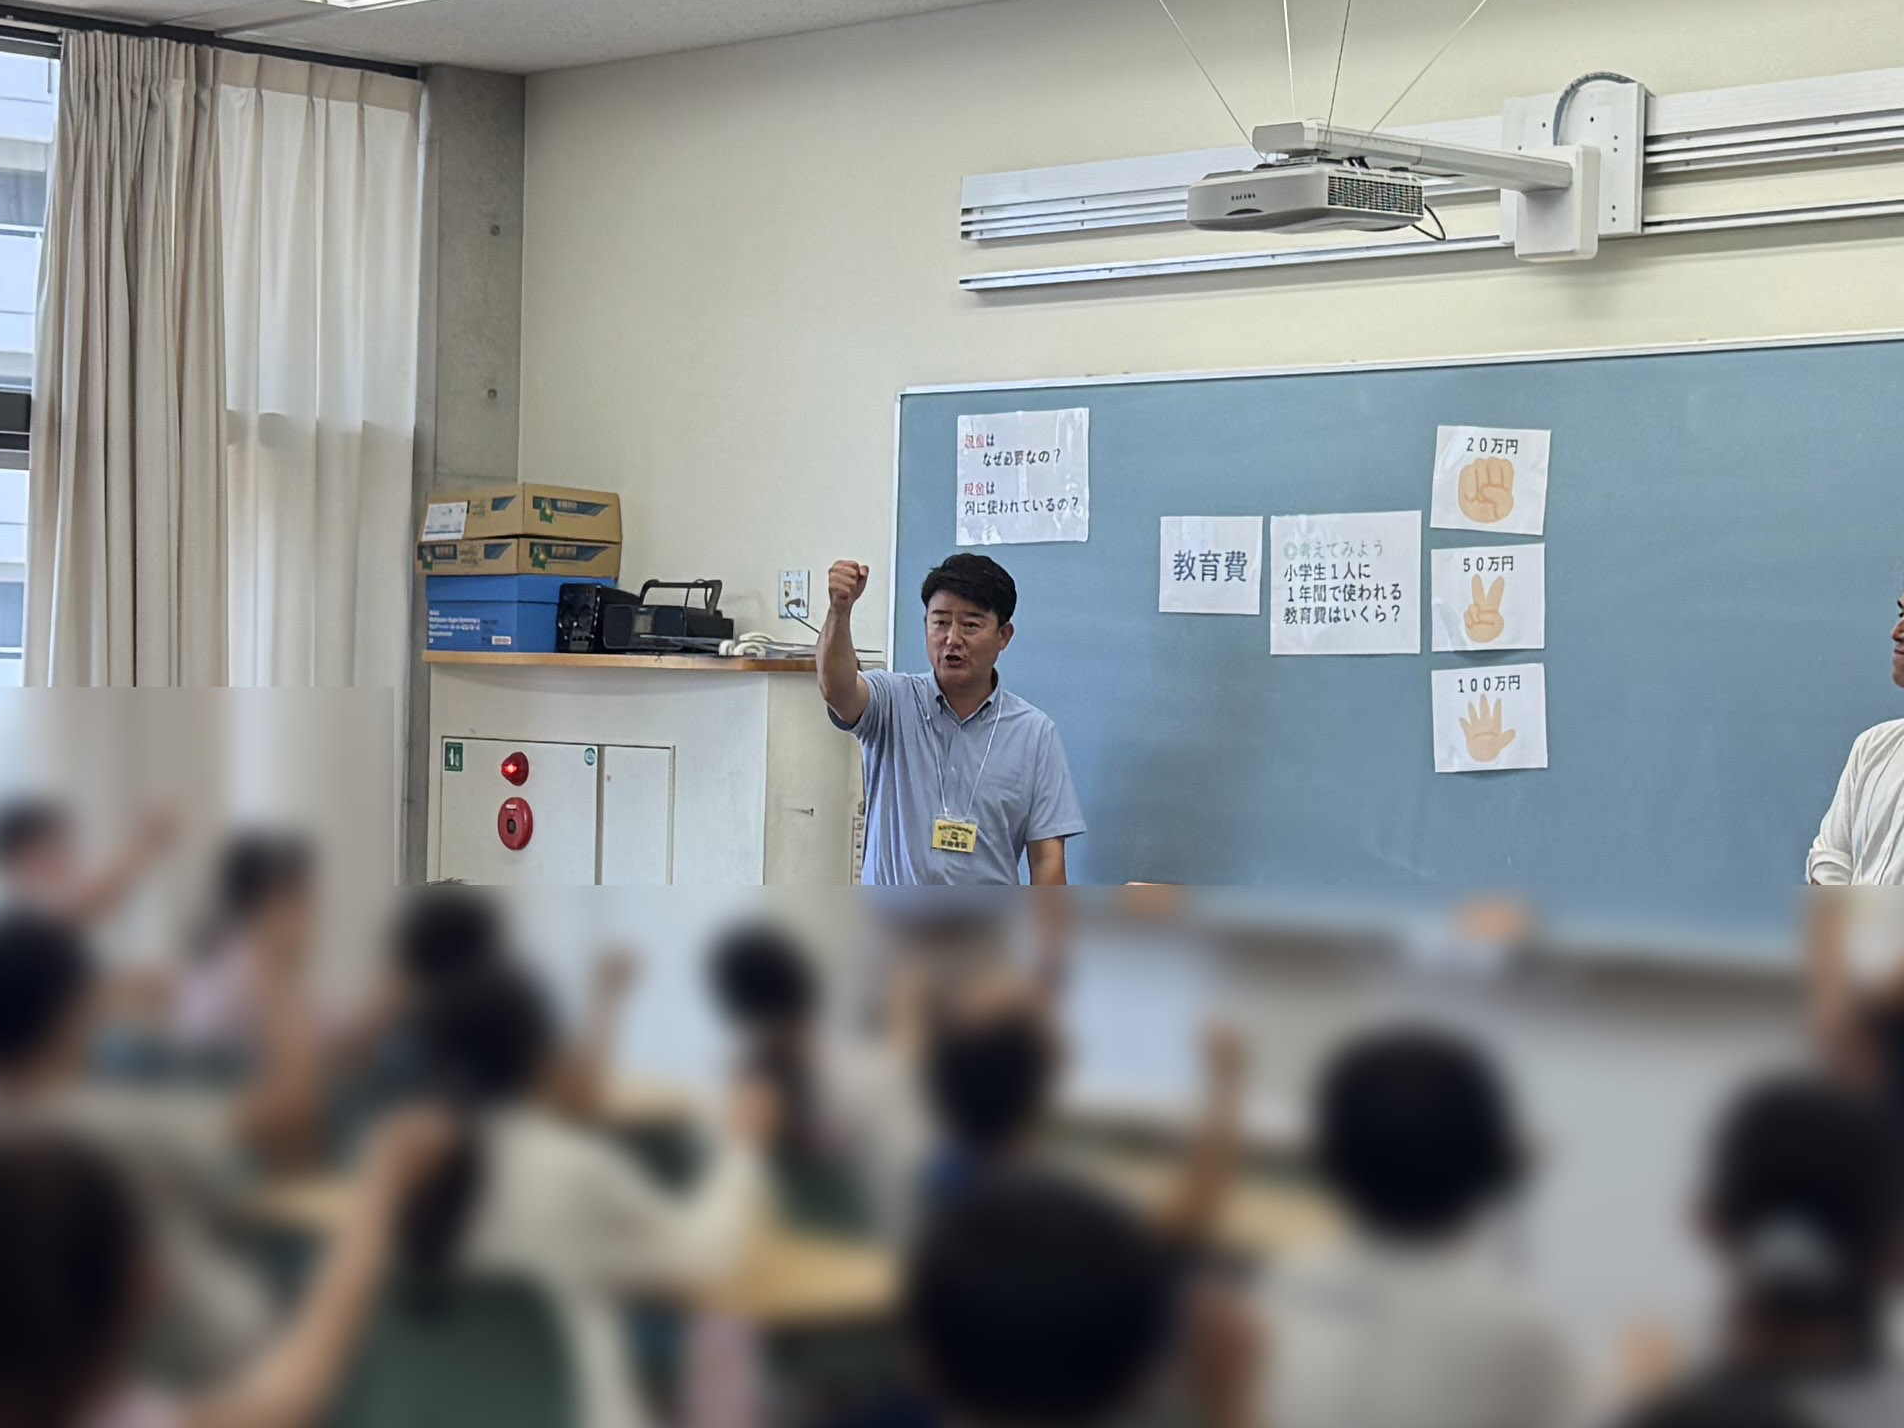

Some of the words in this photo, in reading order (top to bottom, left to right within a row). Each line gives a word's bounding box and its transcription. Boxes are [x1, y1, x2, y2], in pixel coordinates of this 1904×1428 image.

[1466, 437, 1519, 455] 20万円
[1174, 550, 1247, 582] 教育費
[1463, 556, 1514, 572] 50万円
[1458, 674, 1520, 693] 100万円
